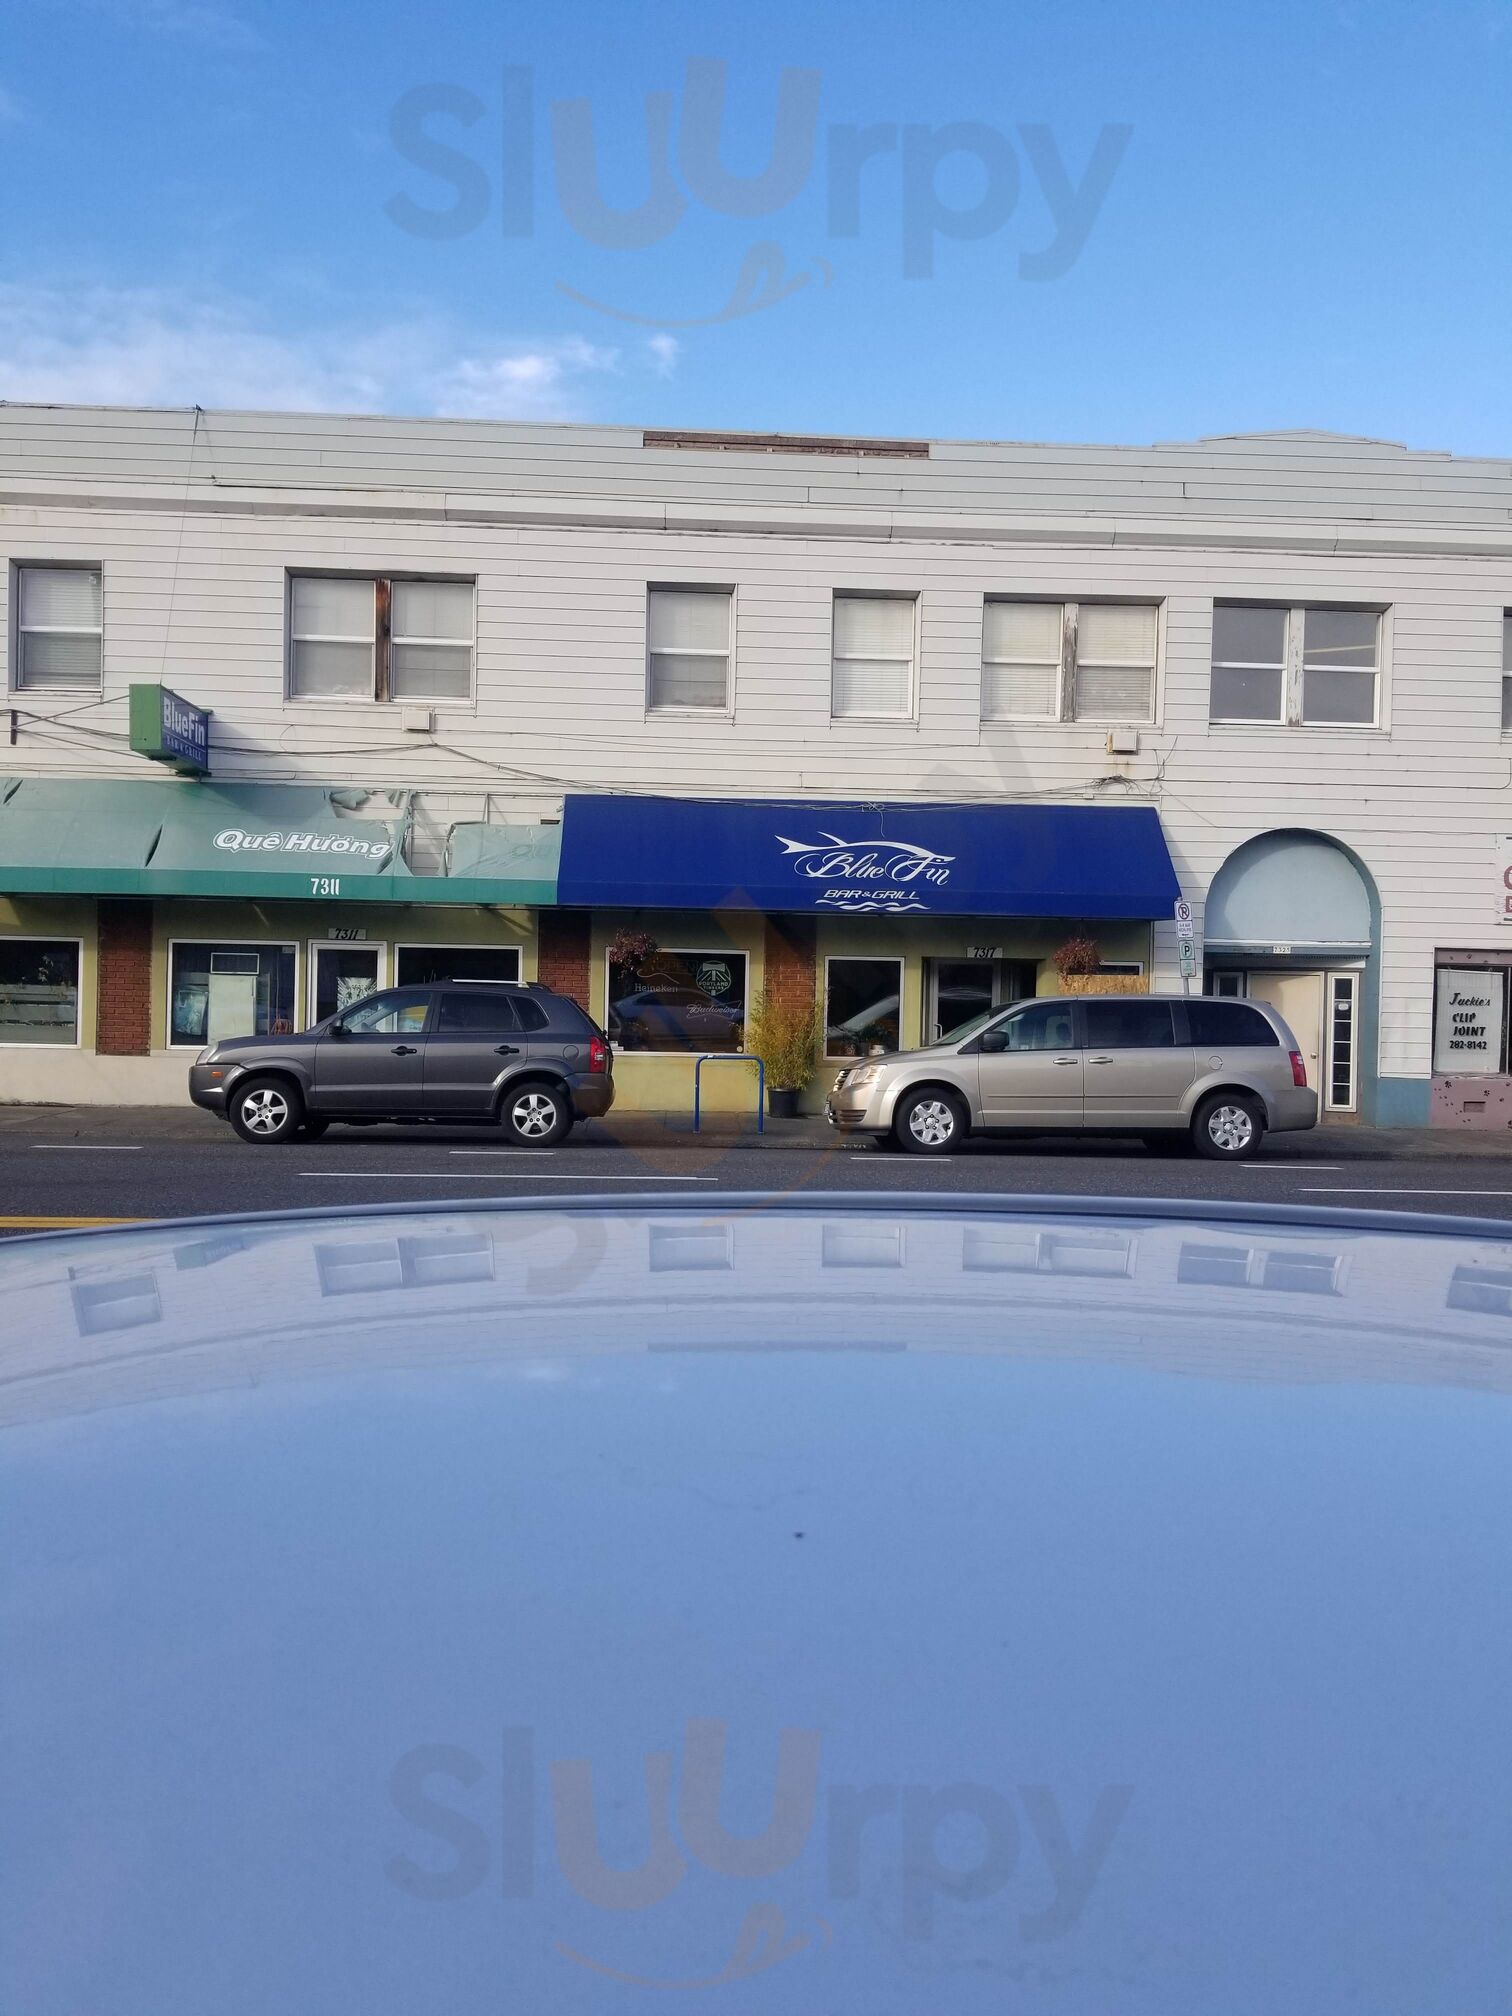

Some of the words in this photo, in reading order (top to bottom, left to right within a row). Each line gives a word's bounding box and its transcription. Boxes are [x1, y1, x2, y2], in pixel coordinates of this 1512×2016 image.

[163, 696, 205, 747] BlueFin
[214, 828, 283, 853] Quê
[794, 851, 885, 878] Blue
[885, 854, 950, 886] Fin
[310, 877, 341, 896] 7311
[335, 928, 358, 940] 7311
[974, 947, 995, 958] 7317
[634, 983, 679, 993] Heineken
[1449, 992, 1491, 1006] Jackie's
[686, 1003, 738, 1014] Budweiser
[1452, 1012, 1477, 1023] CLIP
[1453, 1026, 1486, 1037] JOINT
[1449, 1040, 1488, 1050] 282-8142
